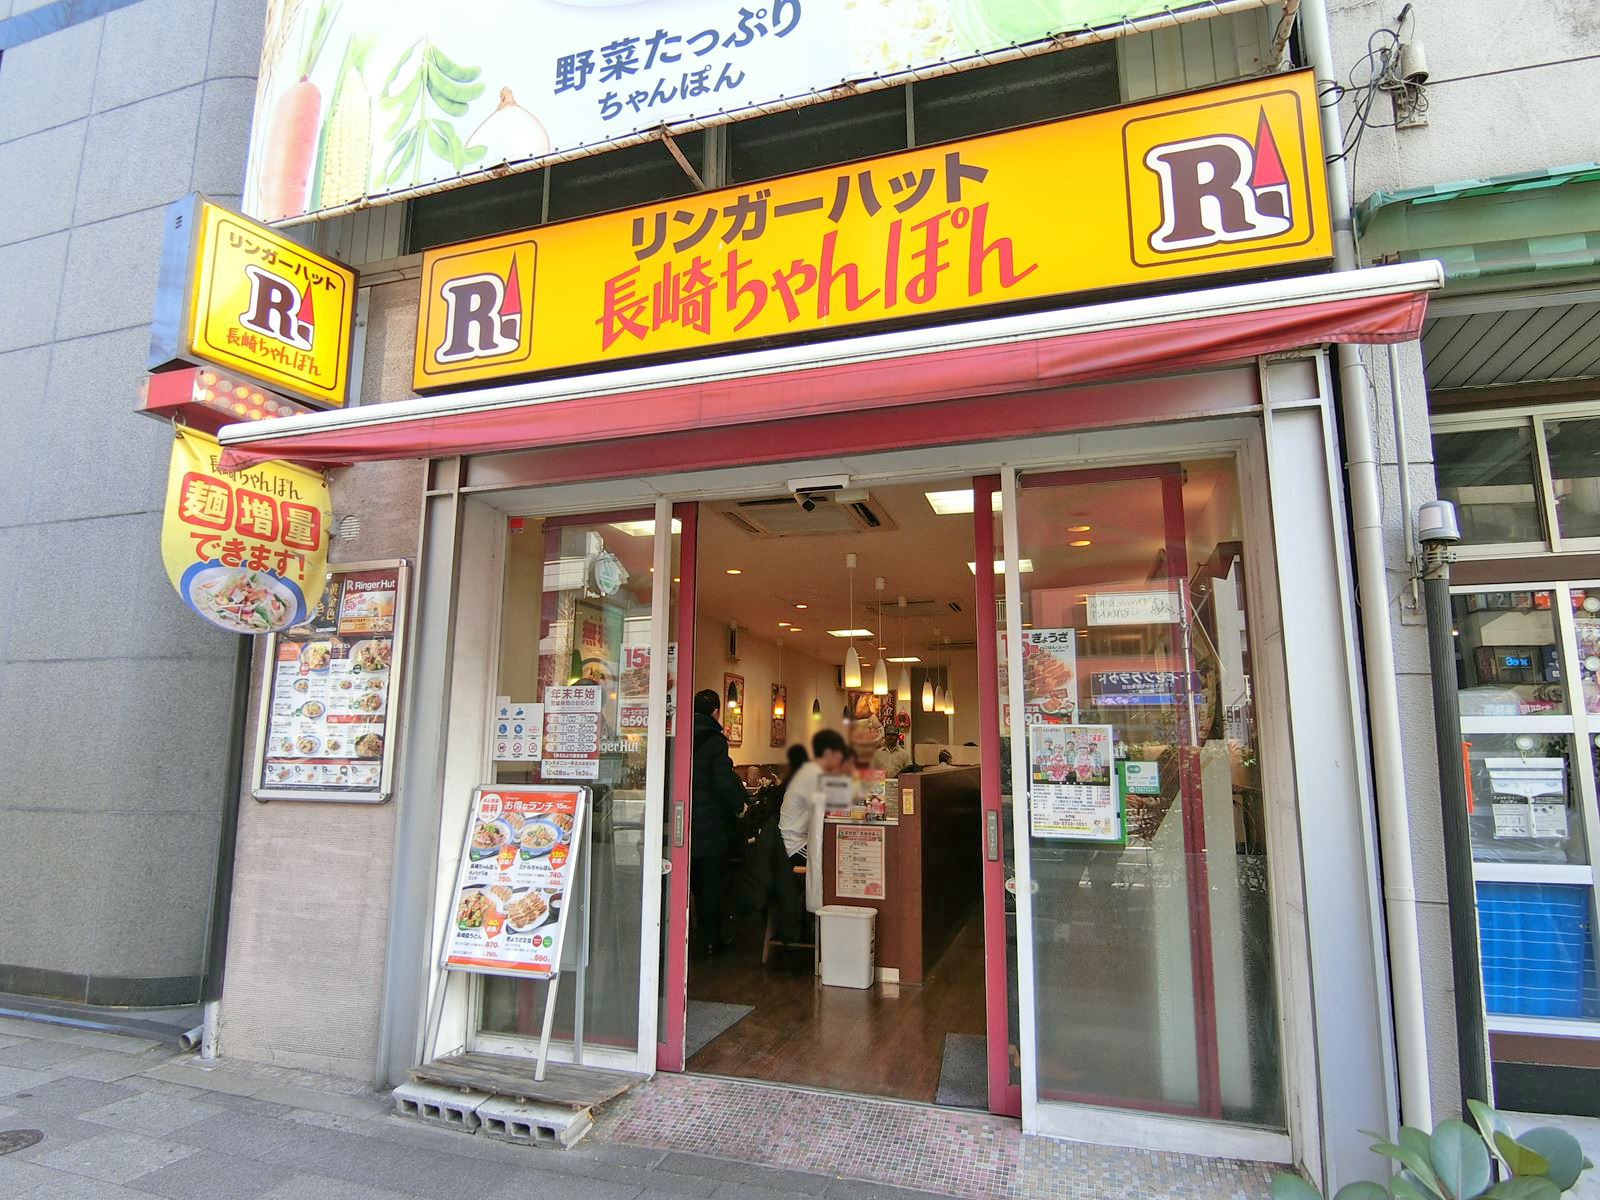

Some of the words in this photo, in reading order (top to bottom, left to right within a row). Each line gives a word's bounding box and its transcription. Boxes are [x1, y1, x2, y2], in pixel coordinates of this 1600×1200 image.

[554, 0, 801, 95] 野菜たっぷり
[598, 62, 746, 121] ちゃんぽん
[631, 152, 988, 260] リンガーハット
[229, 232, 337, 291] リンガーハット
[596, 202, 1038, 352] 長崎ちゃんぽん
[226, 327, 322, 377] 長崎ちゃんぽん
[355, 580, 380, 591] Ringer
[380, 579, 396, 588] Hut
[1032, 632, 1068, 643] ぎょうざ
[551, 688, 595, 700] 年末年始
[504, 800, 554, 810] お得なランチ
